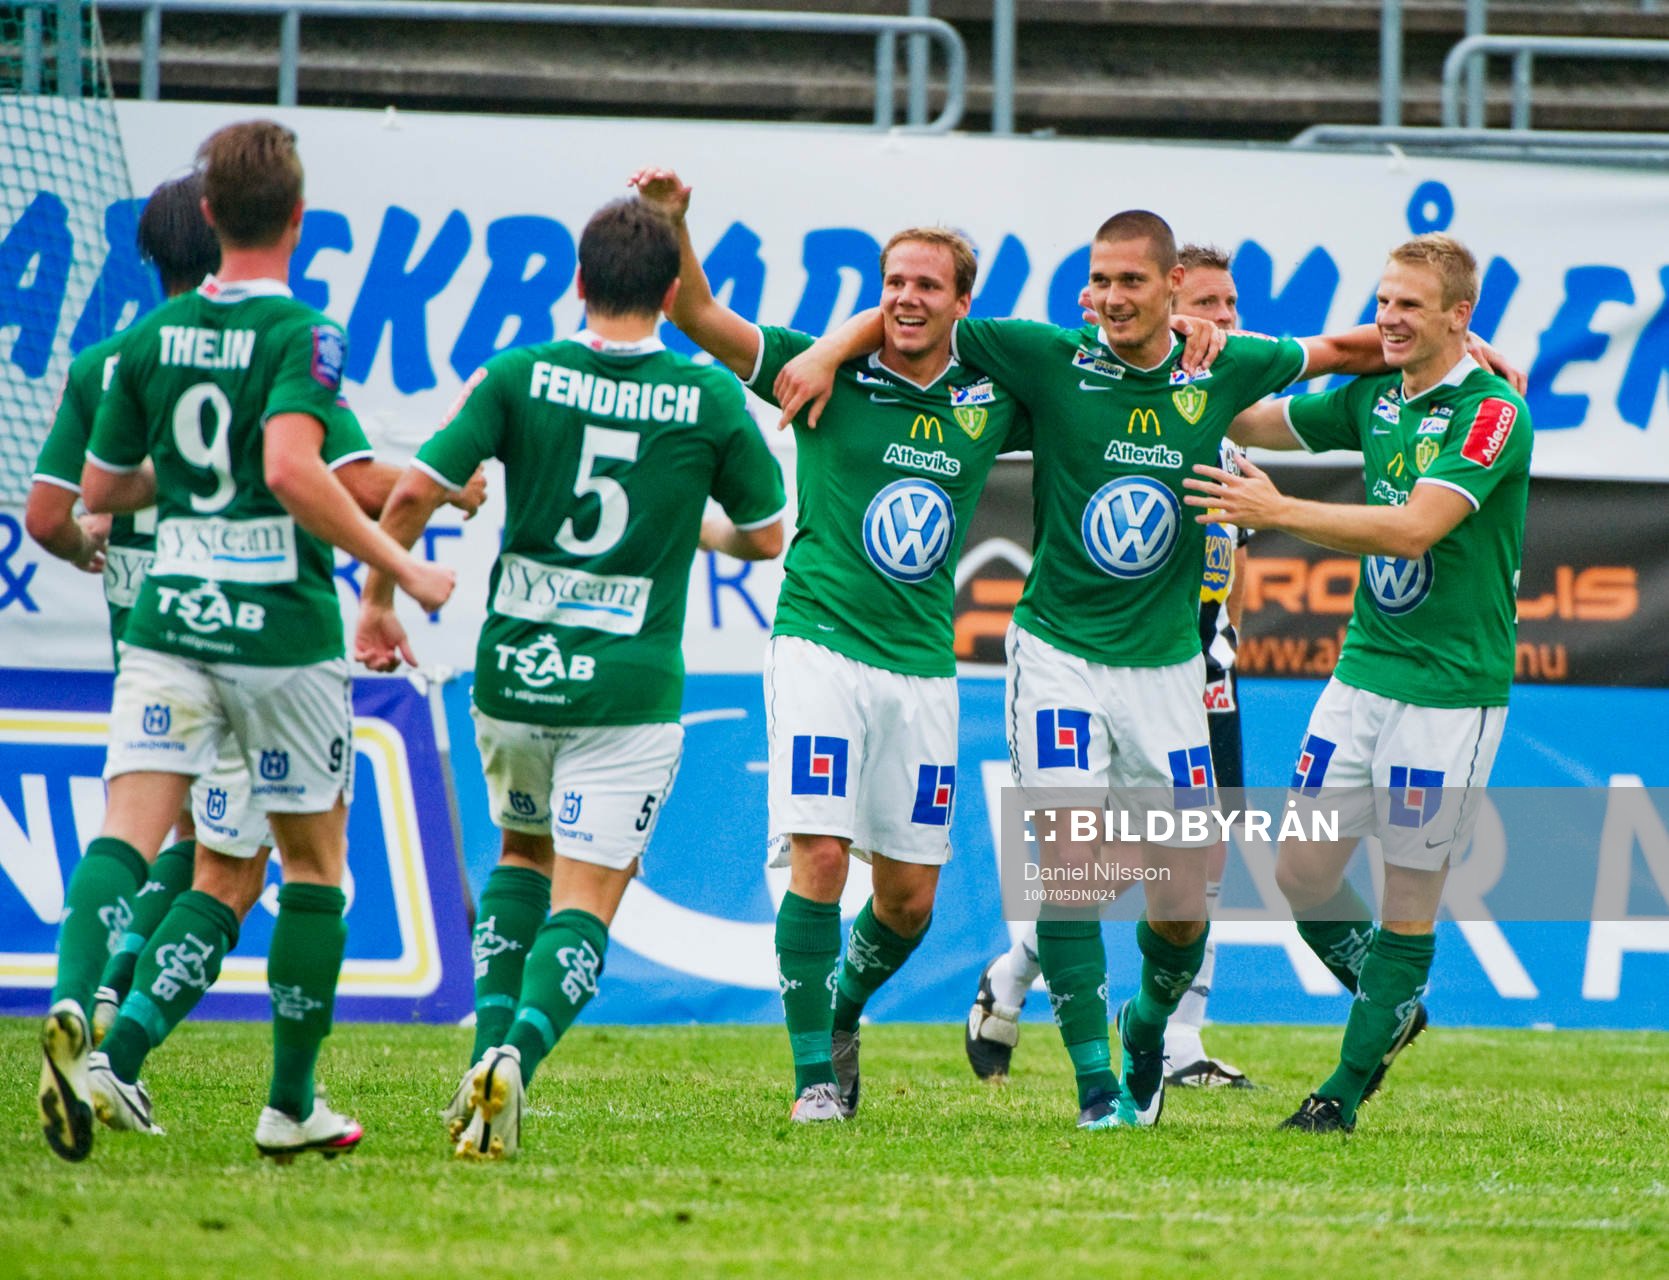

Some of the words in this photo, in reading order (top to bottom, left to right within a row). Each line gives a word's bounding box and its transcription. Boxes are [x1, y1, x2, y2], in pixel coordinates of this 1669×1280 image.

[159, 325, 256, 369] THELIN
[529, 360, 701, 424] FENDRICH
[172, 382, 236, 513] 9
[1105, 440, 1183, 469] Atteviks
[1481, 406, 1513, 462] Adecco
[883, 443, 961, 477] Atteviks
[554, 424, 640, 556] 5
[328, 738, 343, 773] 9
[635, 794, 656, 831] 5
